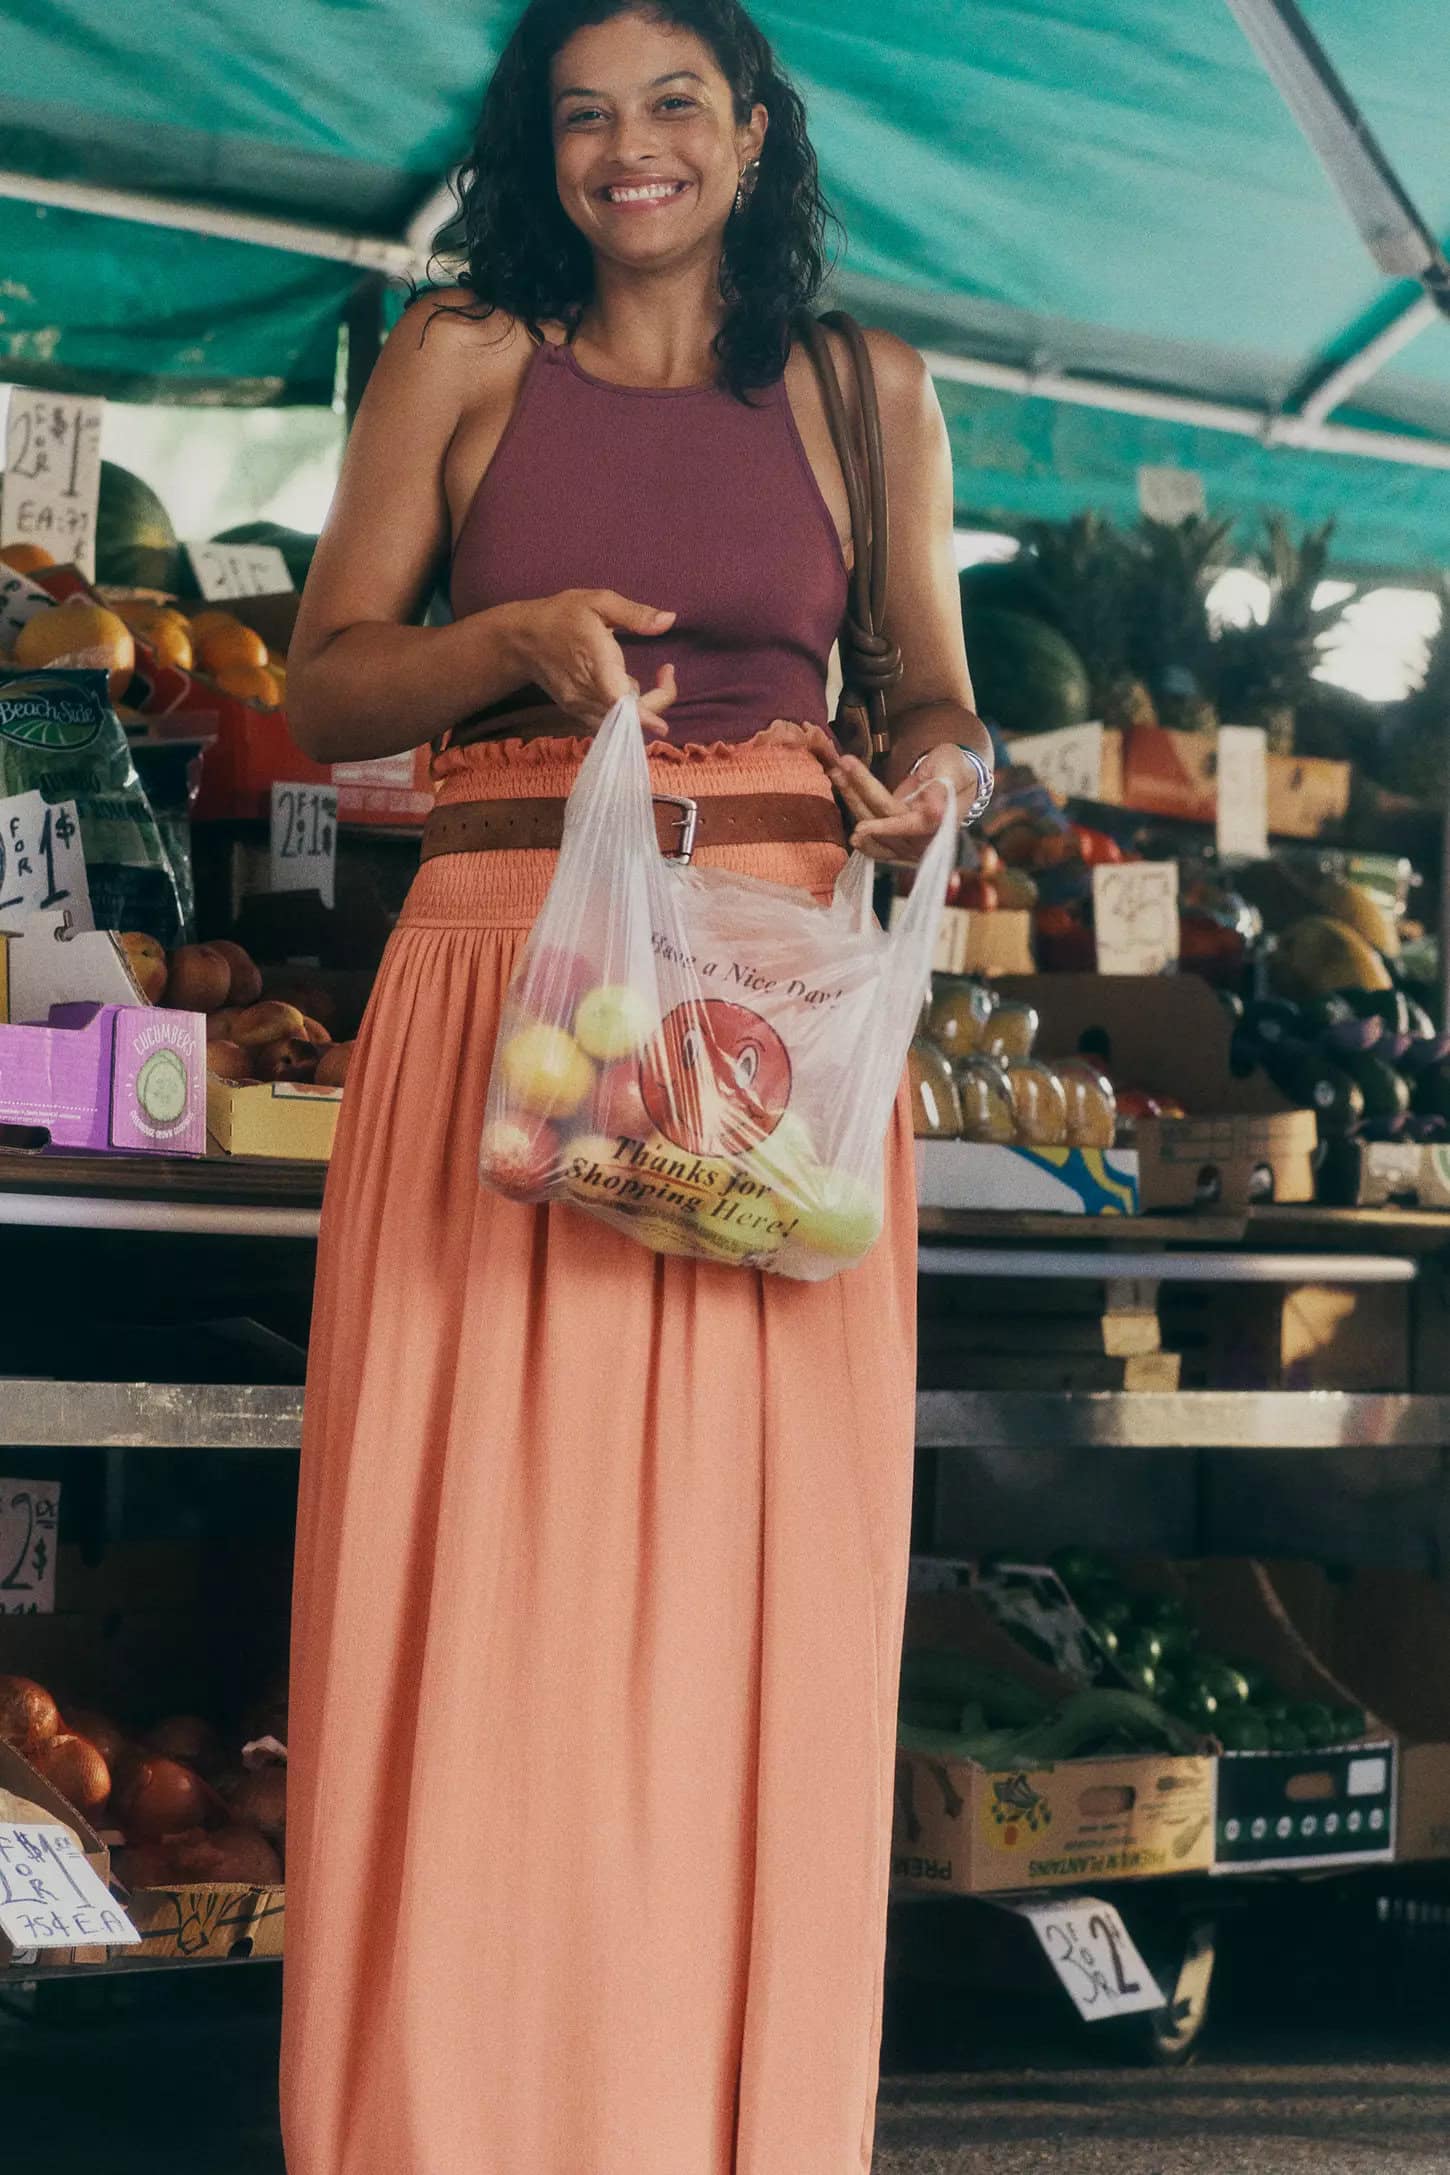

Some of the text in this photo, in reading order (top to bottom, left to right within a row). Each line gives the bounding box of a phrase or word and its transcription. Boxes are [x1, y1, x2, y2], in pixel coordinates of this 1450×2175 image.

[10, 817, 33, 877] FOR
[702, 961, 719, 977] a
[723, 961, 778, 994] Nice
[133, 1023, 197, 1056] CUCUMBERS
[565, 1156, 703, 1214] Shopping
[710, 1199, 800, 1238] Here!
[611, 1135, 772, 1199] Thanks for
